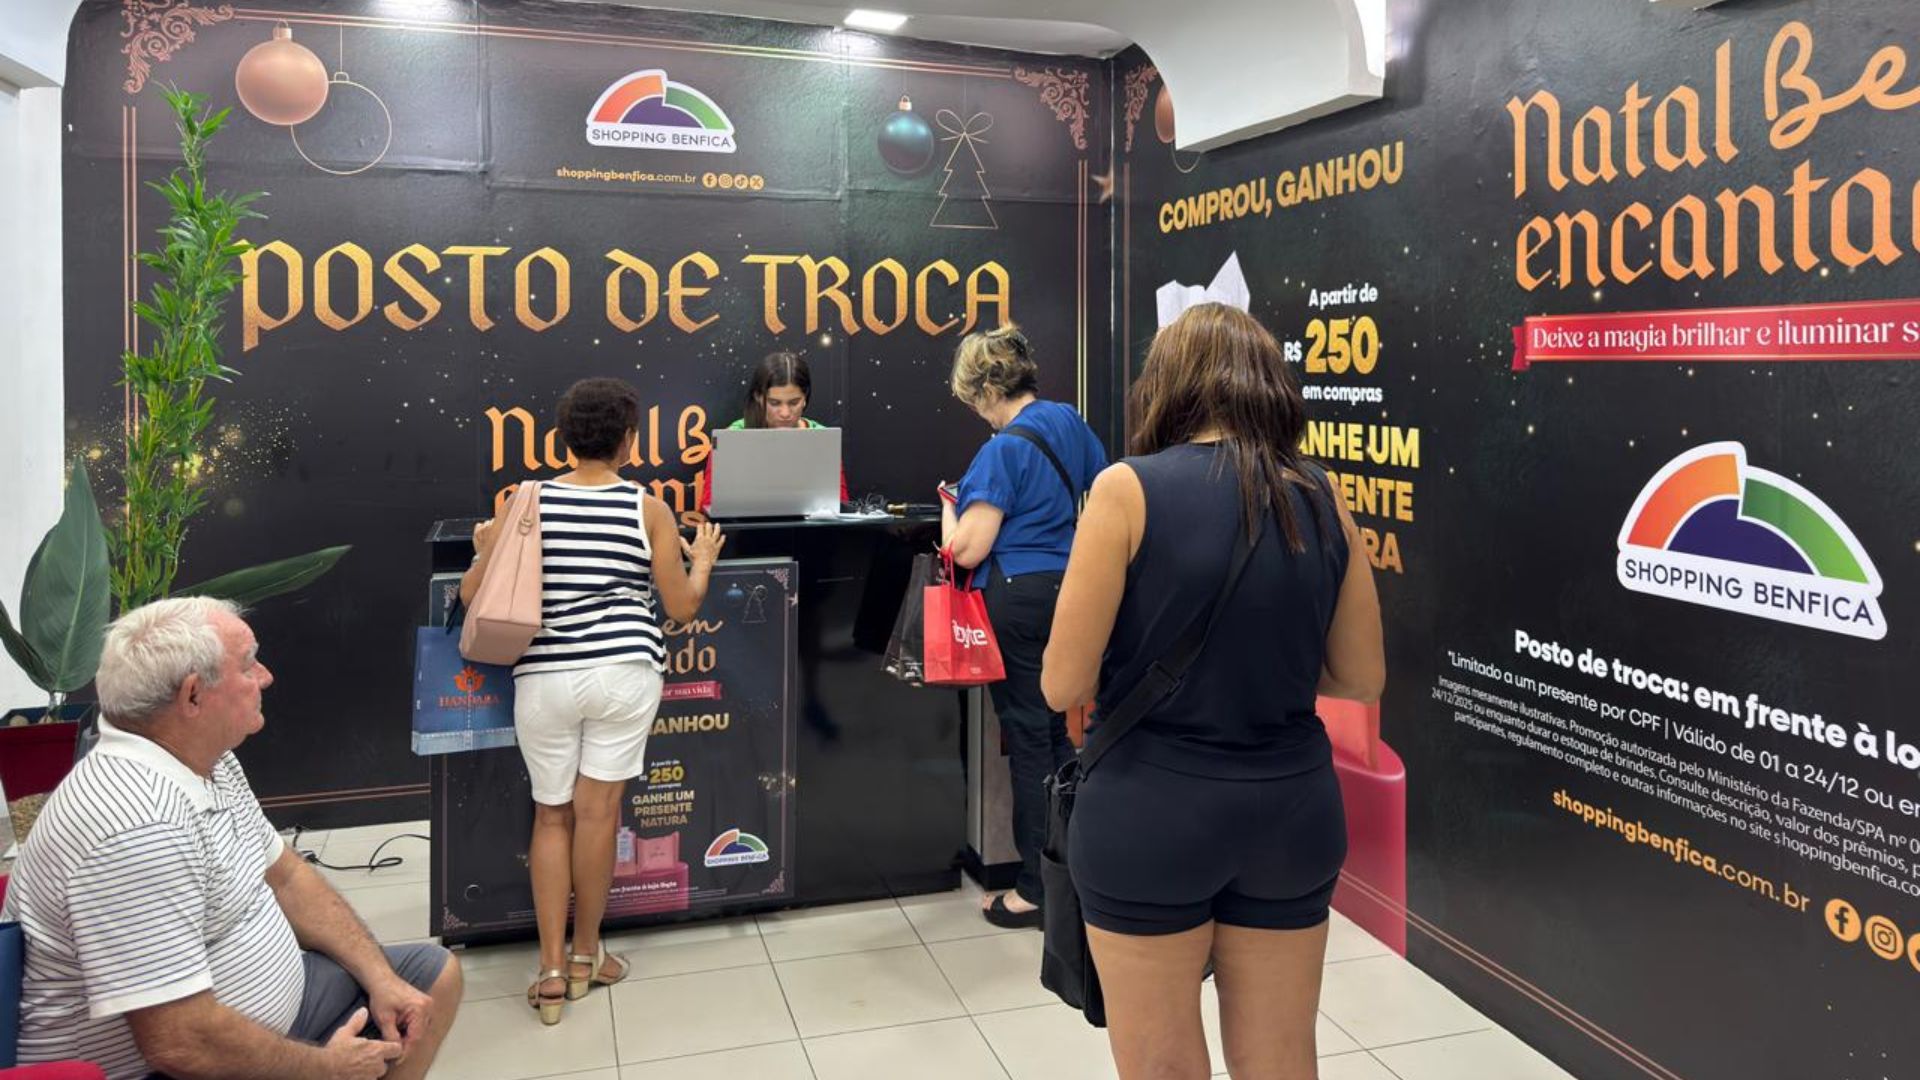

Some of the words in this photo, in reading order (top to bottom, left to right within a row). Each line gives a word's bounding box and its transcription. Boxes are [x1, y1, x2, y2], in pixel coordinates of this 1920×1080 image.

[591, 128, 667, 146] SHOPPING
[671, 133, 731, 149] BENFICA
[1506, 38, 1739, 200] Natal
[556, 166, 697, 185] shoppingbenfica.com.br
[1159, 177, 1272, 233] COMPROU,
[1275, 140, 1404, 208] GANHOU
[1515, 159, 1920, 292] encanta
[235, 239, 512, 352] POSTO
[604, 248, 720, 334] DE
[740, 253, 1011, 337] TROCA
[1308, 288, 1319, 307] A
[1320, 283, 1358, 310] partir
[1359, 282, 1378, 302] de
[1283, 340, 1303, 363] R$
[1304, 315, 1379, 375] 250
[1532, 326, 1584, 348] Deixe
[1588, 330, 1599, 347] a
[1604, 324, 1667, 352] magia
[1672, 320, 1751, 346] brilhar
[1757, 326, 1771, 346] e
[1778, 317, 1895, 345] iluminar
[1302, 384, 1321, 401] em
[1322, 385, 1383, 406] compras
[485, 404, 664, 473] Nal
[1299, 420, 1364, 462] NHE
[1368, 424, 1420, 468] UM
[1625, 558, 1743, 600] SHOPPING
[1753, 582, 1875, 626] BENFICA
[660, 618, 724, 636] em
[649, 712, 730, 736] ANHOU
[1514, 629, 1575, 669] Posto
[1577, 648, 1609, 678] de
[1612, 658, 1690, 703] troca:
[1693, 686, 1741, 718] em
[1745, 693, 1848, 748] frente
[1853, 722, 1879, 759] à
[1886, 729, 1920, 775] lo
[1437, 675, 1471, 695] Imagens
[1471, 686, 1519, 712] meramente
[1519, 701, 1569, 731] ilustrativas.
[1569, 719, 1619, 748] Promoção
[1620, 740, 1677, 769] autorizada
[1679, 760, 1705, 779] pelo
[1707, 767, 1769, 802] Ministério
[1771, 790, 1790, 809] da
[1792, 797, 1886, 844] Fazenda/SPA
[1503, 672, 1513, 684] a
[1514, 675, 1537, 692] um
[1538, 681, 1599, 712] presente
[1600, 702, 1626, 721] por
[1628, 708, 1662, 732] CPF
[1672, 721, 1727, 755] Válido
[1731, 742, 1756, 764] de
[1759, 750, 1780, 773] 01
[1785, 763, 1799, 780] a
[1803, 764, 1860, 799] 24/12
[1864, 788, 1894, 810] ou
[632, 792, 674, 805] GANHE
[675, 790, 695, 801] UM
[649, 765, 684, 784] 250
[1431, 686, 1473, 711] 24/12/2025
[1473, 702, 1485, 715] ou
[1486, 705, 1526, 730] enquanto
[1526, 721, 1551, 739] durar
[1551, 732, 1559, 742] o
[1560, 735, 1599, 757] estoque
[1600, 747, 1614, 763] de
[1615, 751, 1657, 780] brindes.
[1658, 769, 1710, 798] Consulte
[1711, 789, 1773, 825] descrição,
[1775, 812, 1811, 836] valor
[1813, 825, 1840, 847] dos
[1842, 837, 1909, 874] prêmios,
[1454, 711, 1507, 739] participantes,
[1507, 732, 1564, 760] regulamento
[1564, 752, 1612, 779] completo
[1612, 771, 1620, 782] e
[1620, 774, 1655, 796] outras
[1656, 784, 1728, 824] informações
[1730, 815, 1747, 831] no
[1749, 821, 1772, 841] site
[634, 801, 693, 817] PRESENTE
[640, 814, 688, 829] NATURA
